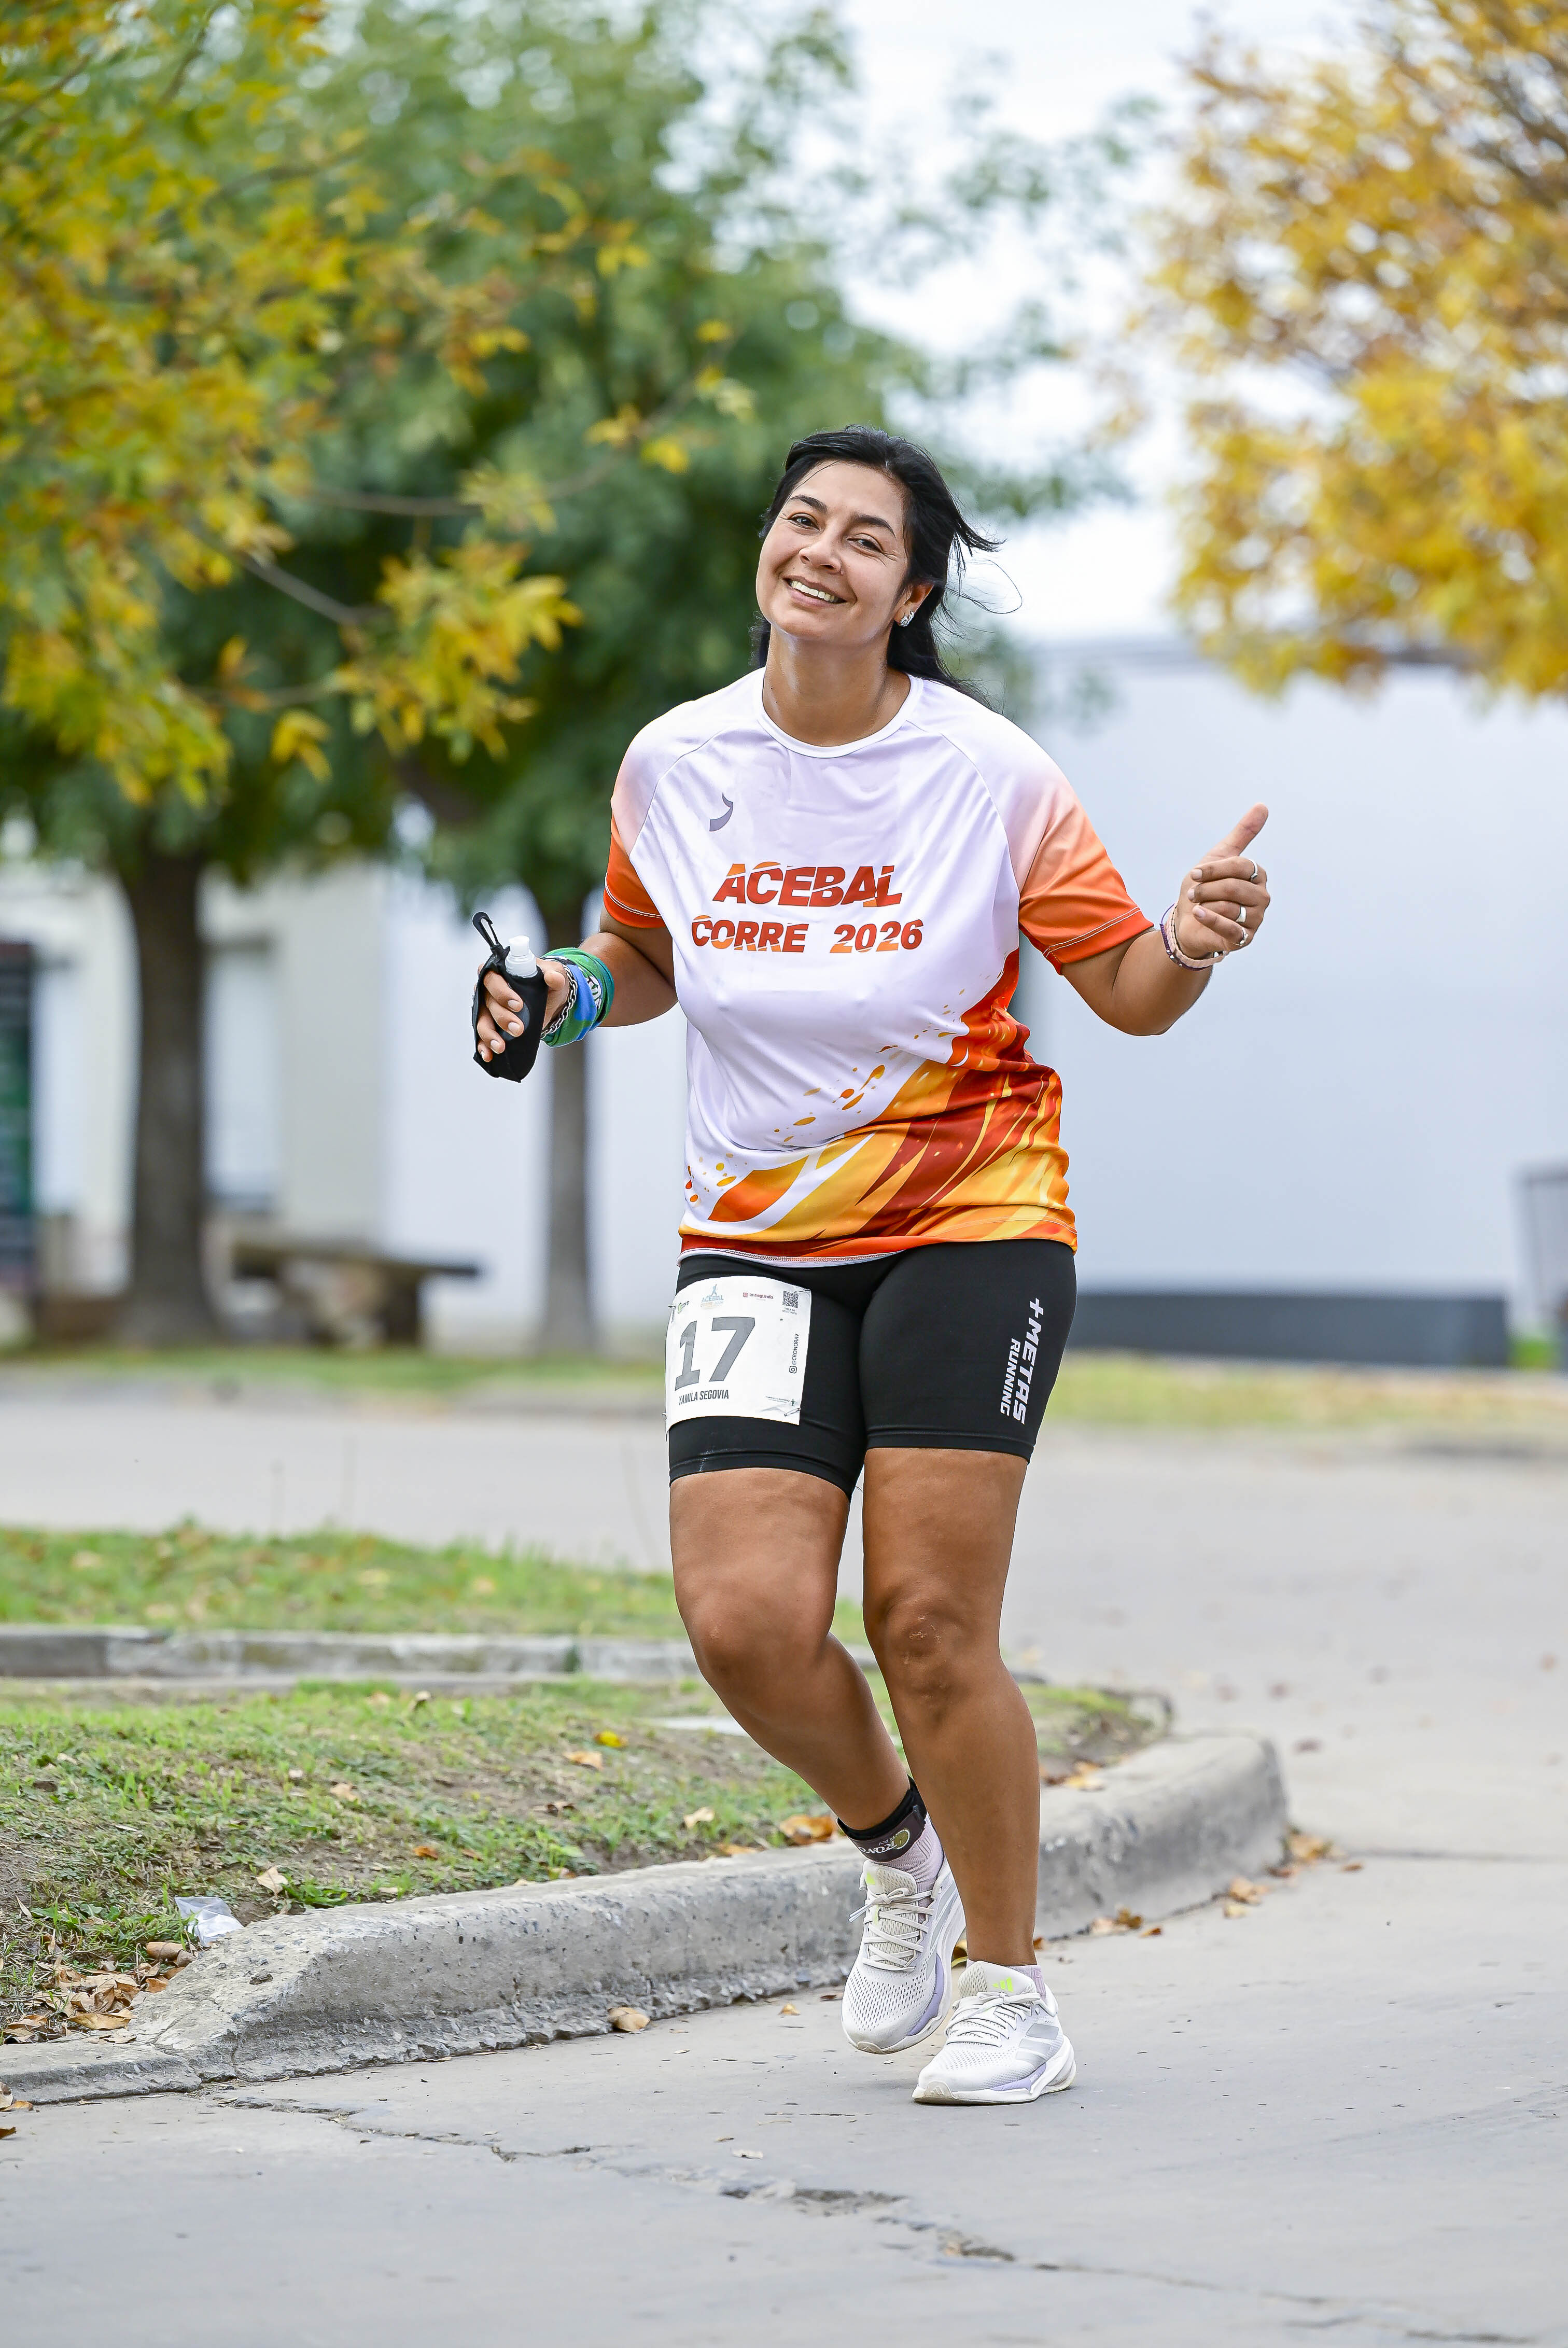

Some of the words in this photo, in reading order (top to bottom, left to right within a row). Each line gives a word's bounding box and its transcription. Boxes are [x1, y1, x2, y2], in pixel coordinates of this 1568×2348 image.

[712, 861, 903, 907] ACEBAL
[691, 915, 809, 953] CORRE
[829, 919, 924, 954] 2026
[675, 1316, 755, 1391] 17
[679, 1391, 698, 1406] YAMILA
[699, 1389, 730, 1401] SEGOVIA
[1000, 1338, 1021, 1416] RUNNING
